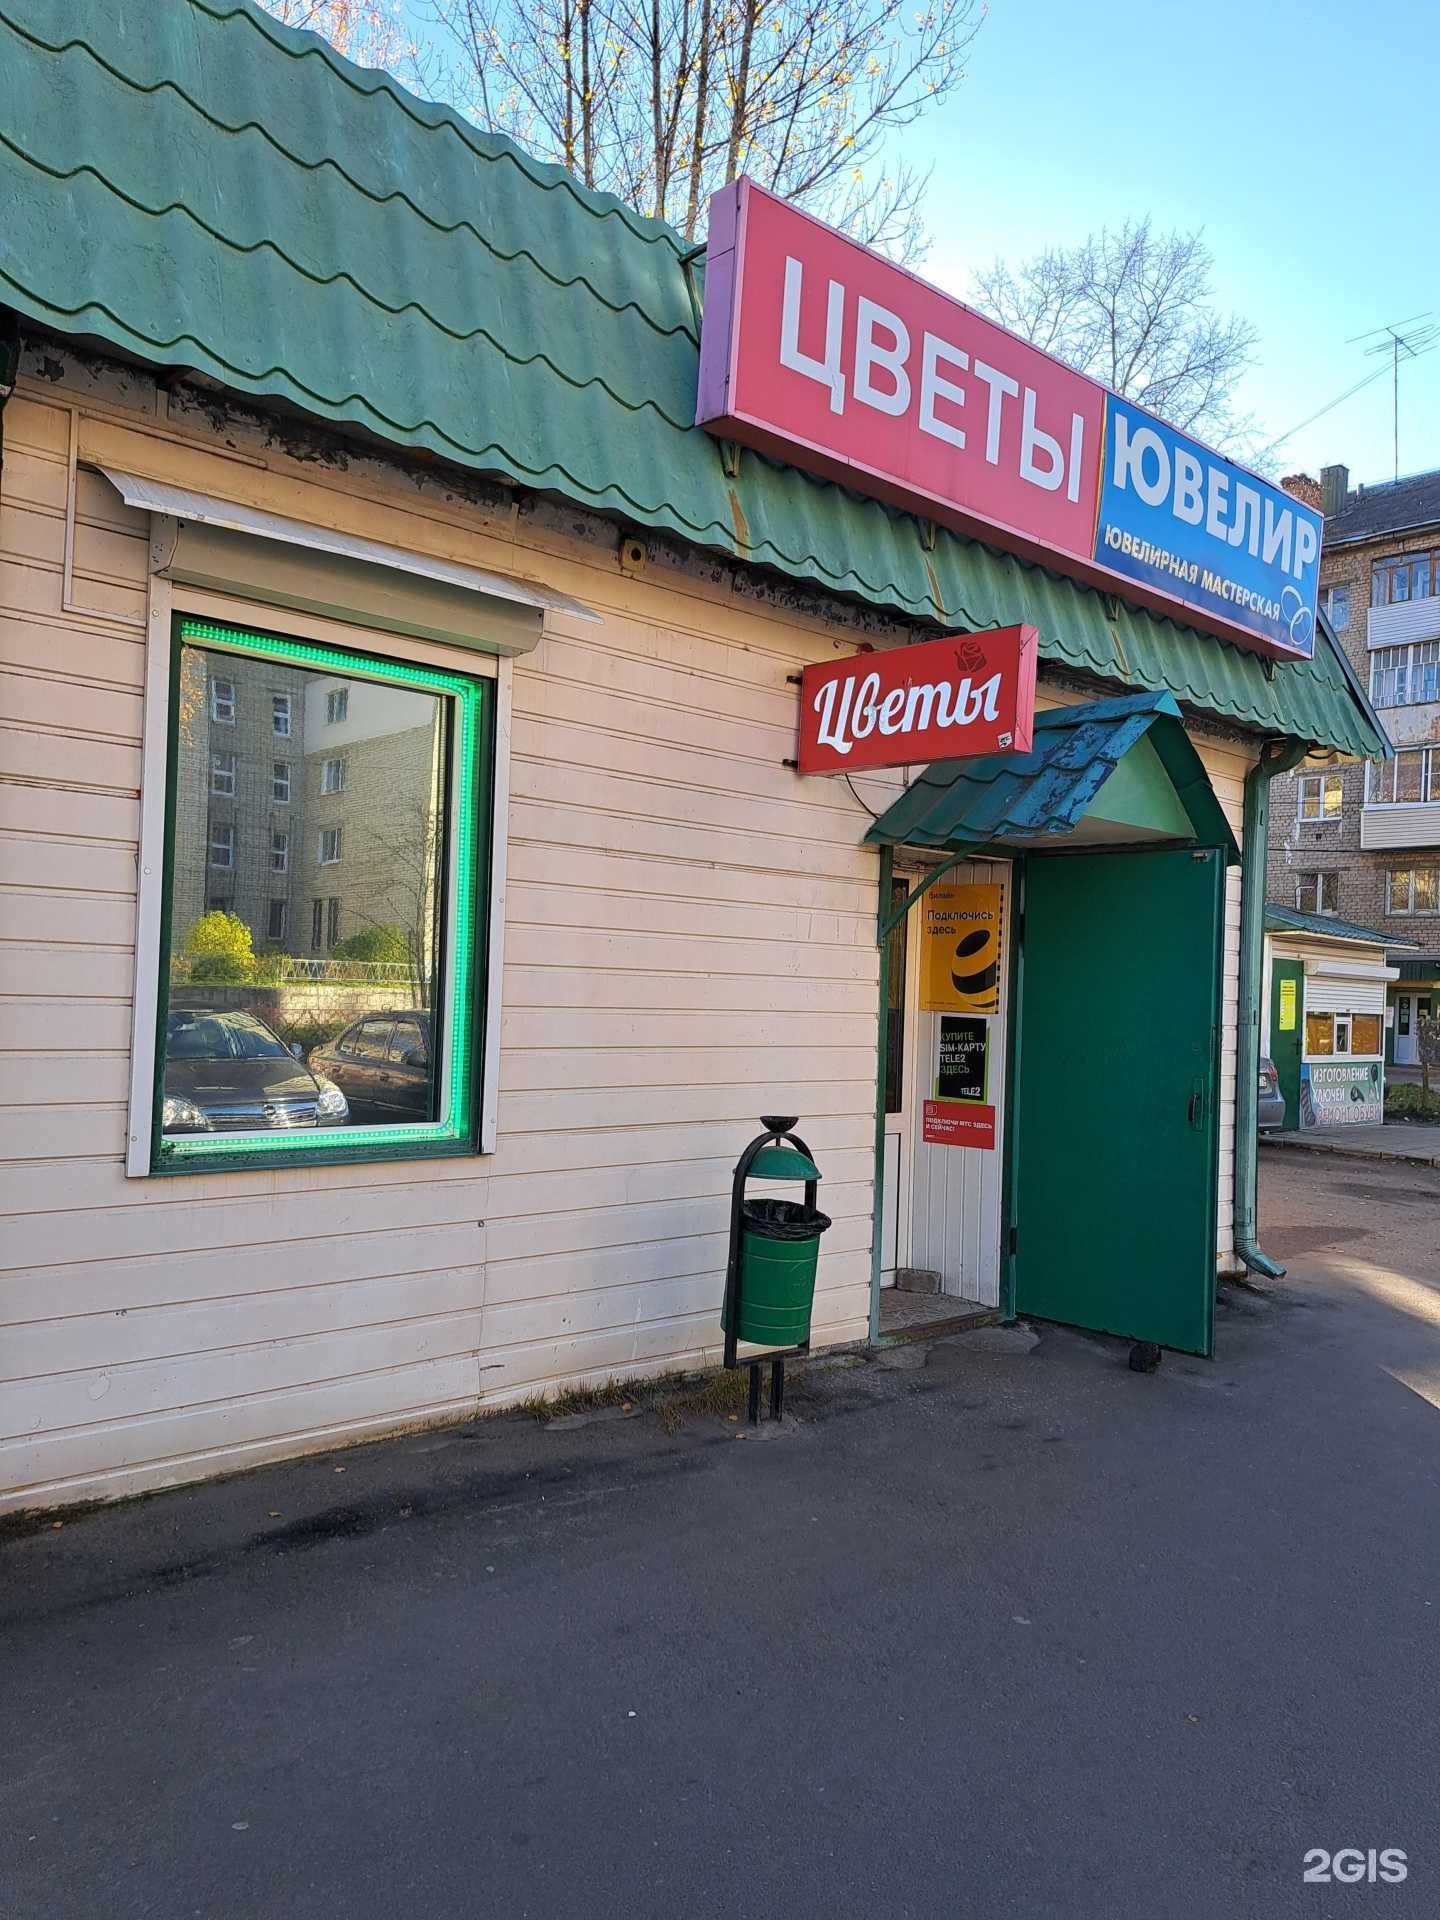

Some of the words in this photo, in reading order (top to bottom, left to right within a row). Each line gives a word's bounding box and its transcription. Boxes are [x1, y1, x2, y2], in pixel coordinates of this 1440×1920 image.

[780, 255, 1084, 503] ЦВЕТЫ
[1112, 412, 1317, 580] ЮВЕЛИР
[1104, 524, 1199, 585] ЮВЕЛИРНАЯ
[1201, 569, 1281, 622] МАСТЕРСКАЯ
[814, 672, 1002, 754] Цветы
[927, 910, 994, 921] Подключись
[927, 925, 957, 935] здесь
[939, 1042, 987, 1053] SIM-КАРТУ
[940, 1054, 966, 1063] TELE2
[940, 1065, 970, 1075] ЗДЕСЬ
[1313, 1066, 1369, 1083] ИЗГОТОВЛЕНИЕ
[960, 1086, 981, 1097] TELE2
